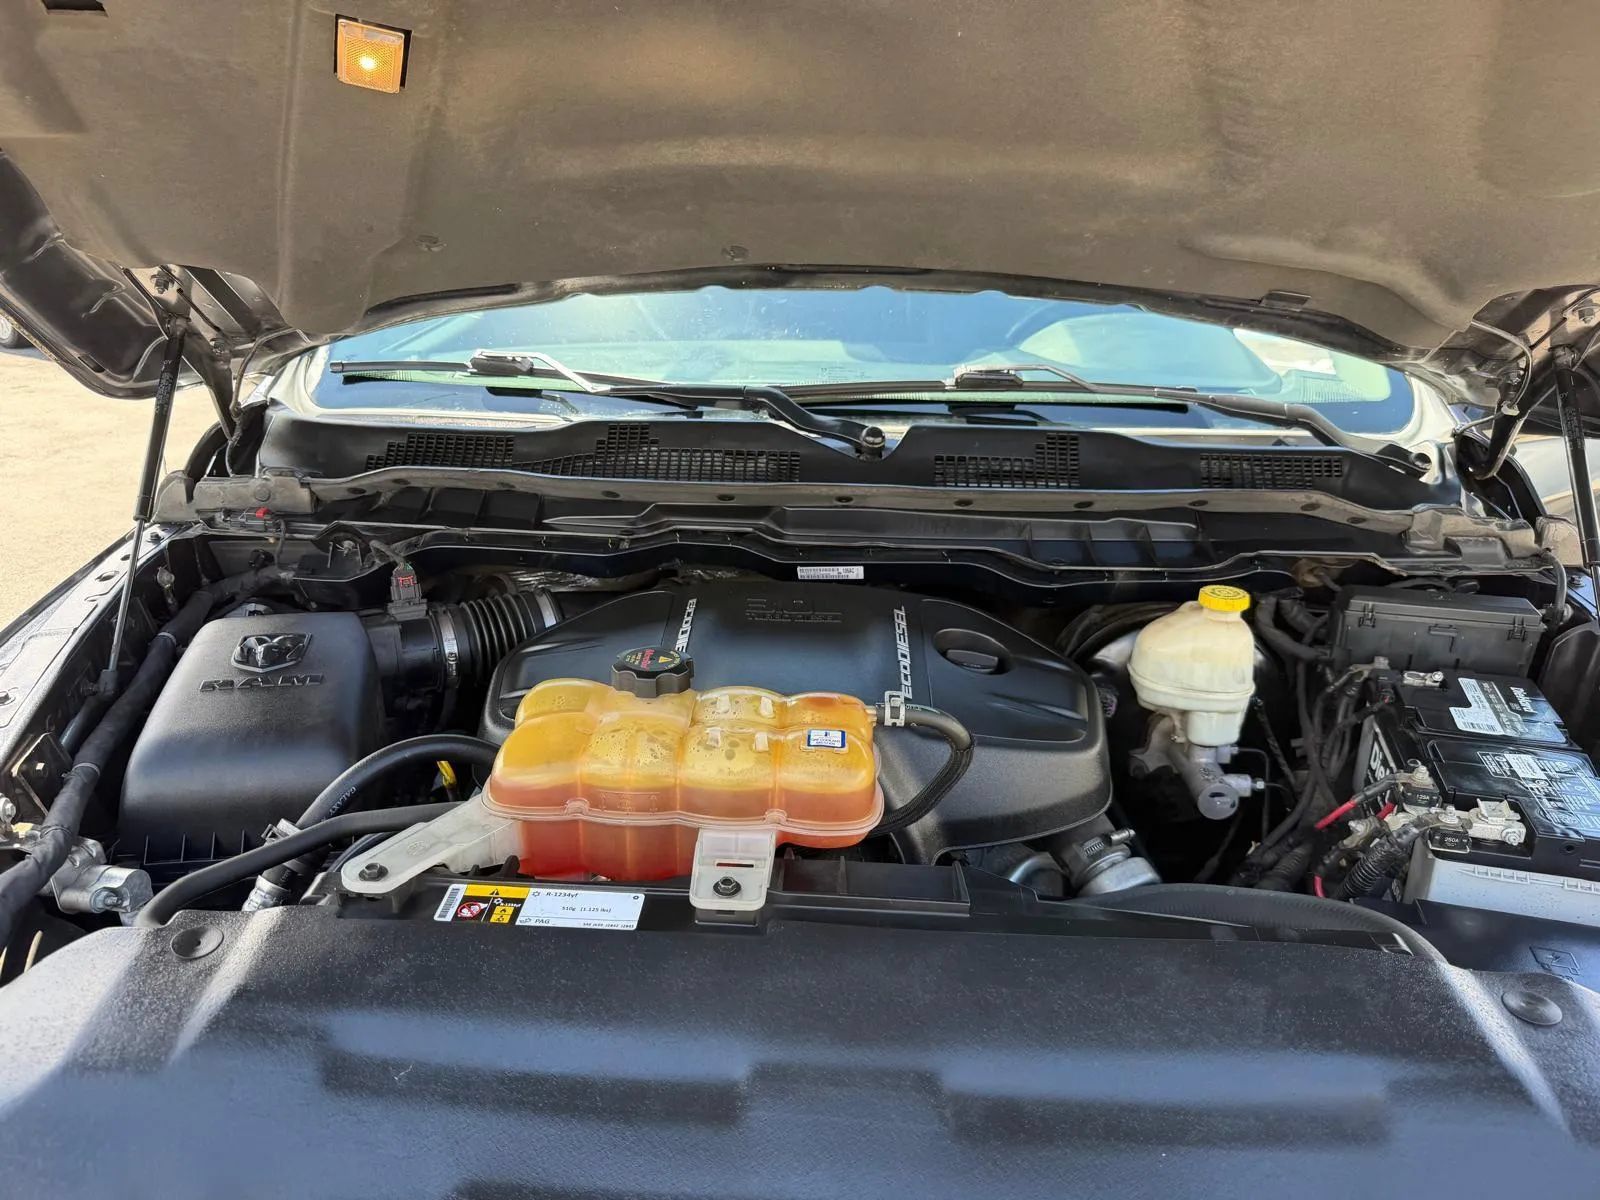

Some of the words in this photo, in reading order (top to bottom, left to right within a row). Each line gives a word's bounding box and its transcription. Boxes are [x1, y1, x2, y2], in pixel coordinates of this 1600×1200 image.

[675, 598, 697, 652] ECODIE
[893, 604, 913, 700] ECODIESEL
[199, 673, 324, 692] RAM
[328, 786, 357, 816] GALAXY
